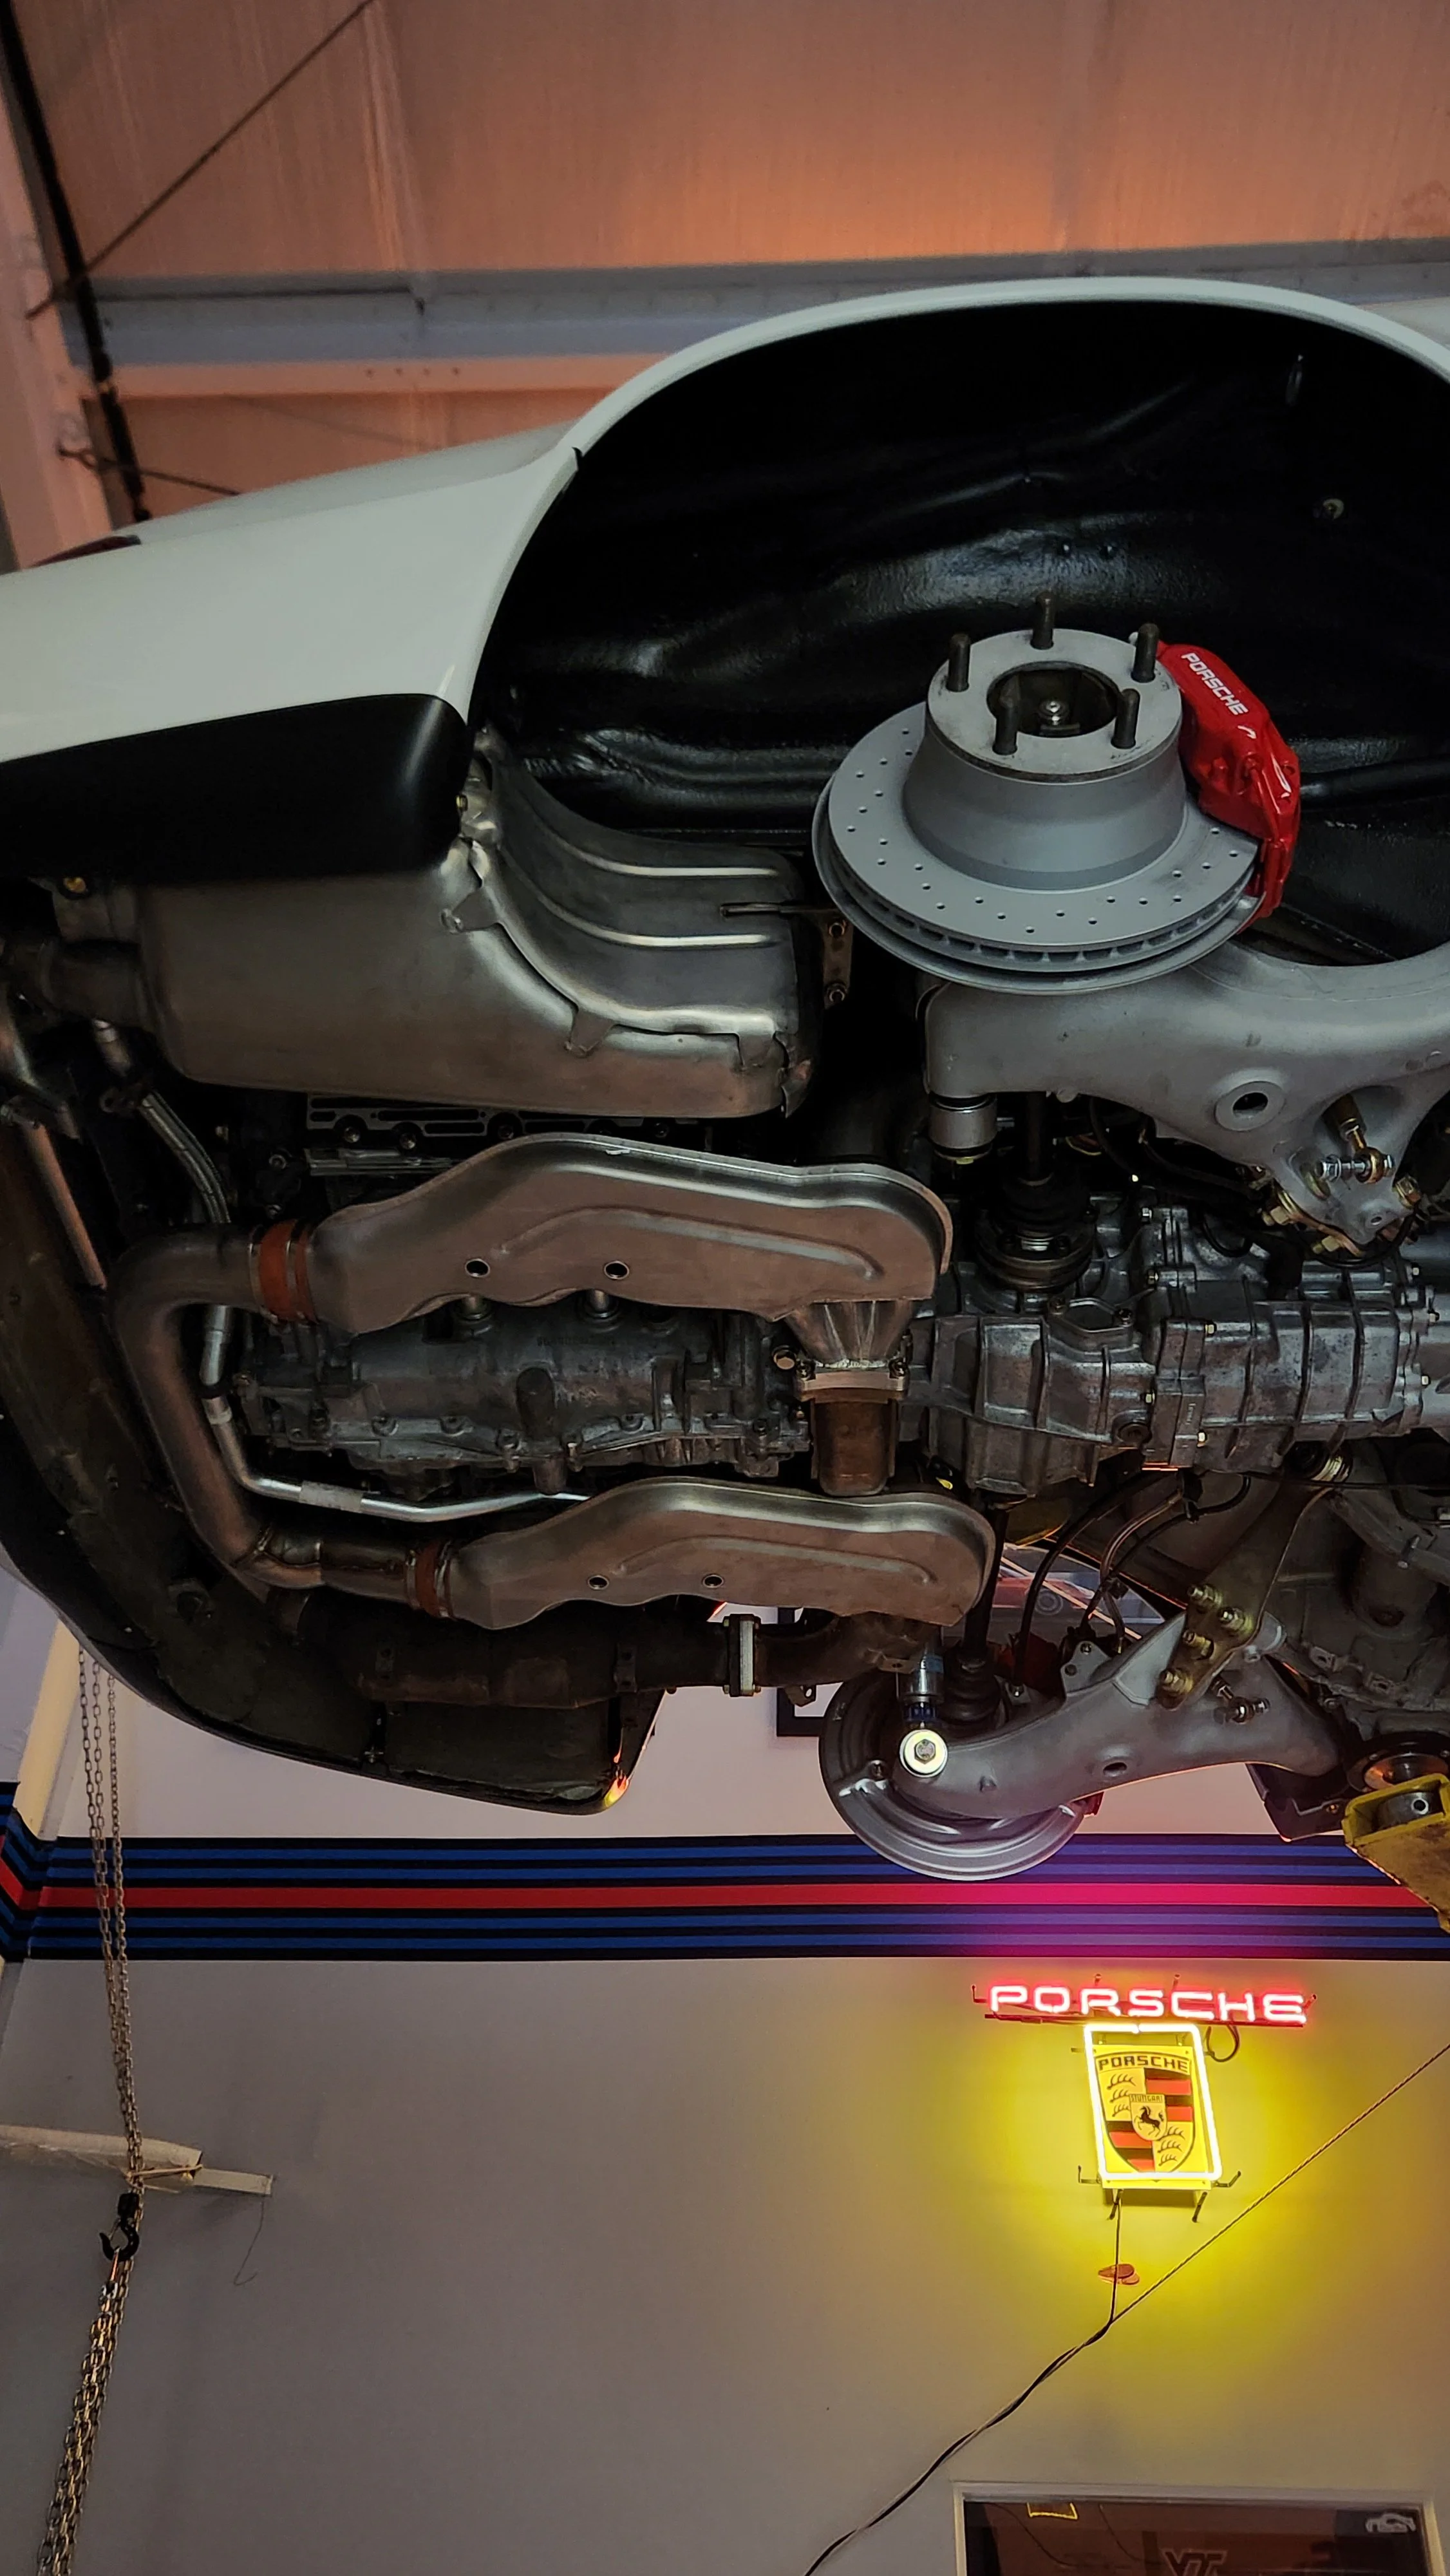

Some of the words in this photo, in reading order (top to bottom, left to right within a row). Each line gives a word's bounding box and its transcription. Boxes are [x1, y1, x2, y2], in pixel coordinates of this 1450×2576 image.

[1181, 652, 1249, 715] PORSCHE
[990, 1985, 1307, 2024] PORSCHE
[1098, 2055, 1188, 2073] PORSCHE
